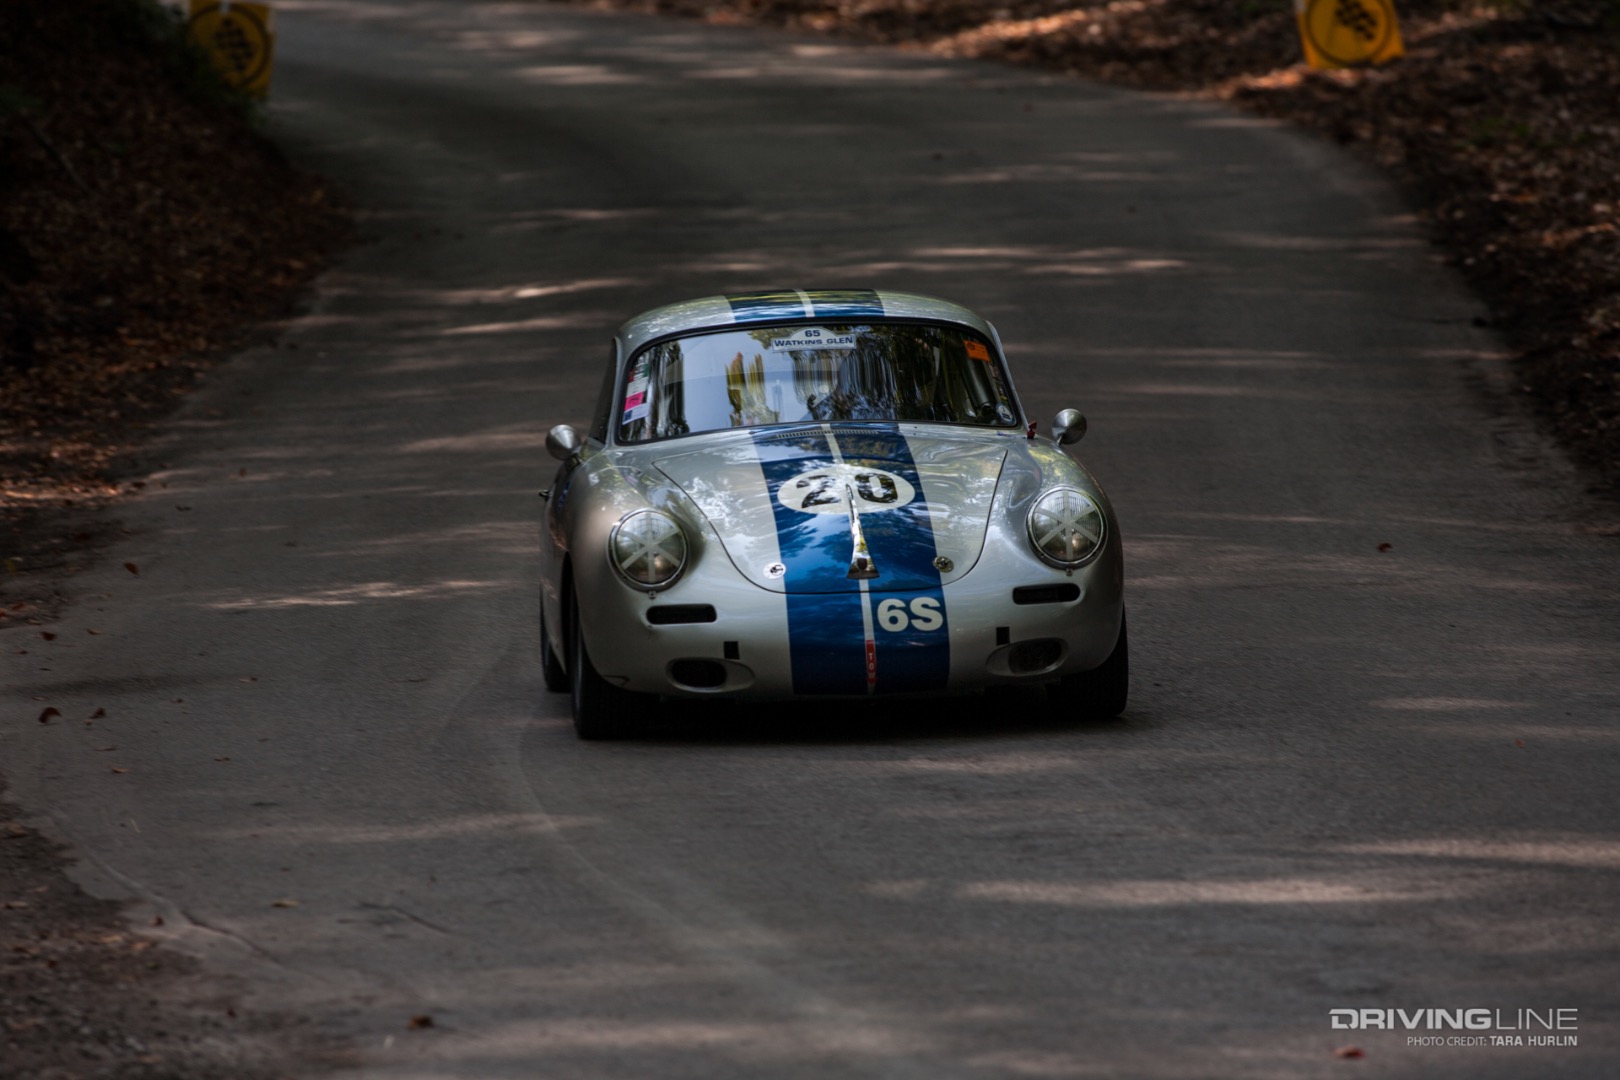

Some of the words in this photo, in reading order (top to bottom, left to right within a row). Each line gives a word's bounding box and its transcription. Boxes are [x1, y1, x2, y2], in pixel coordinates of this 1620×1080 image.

[774, 339, 823, 347] WATKINS
[826, 337, 854, 345] GLEN
[805, 329, 820, 338] 65
[796, 472, 898, 508] 20
[877, 596, 944, 632] 6S
